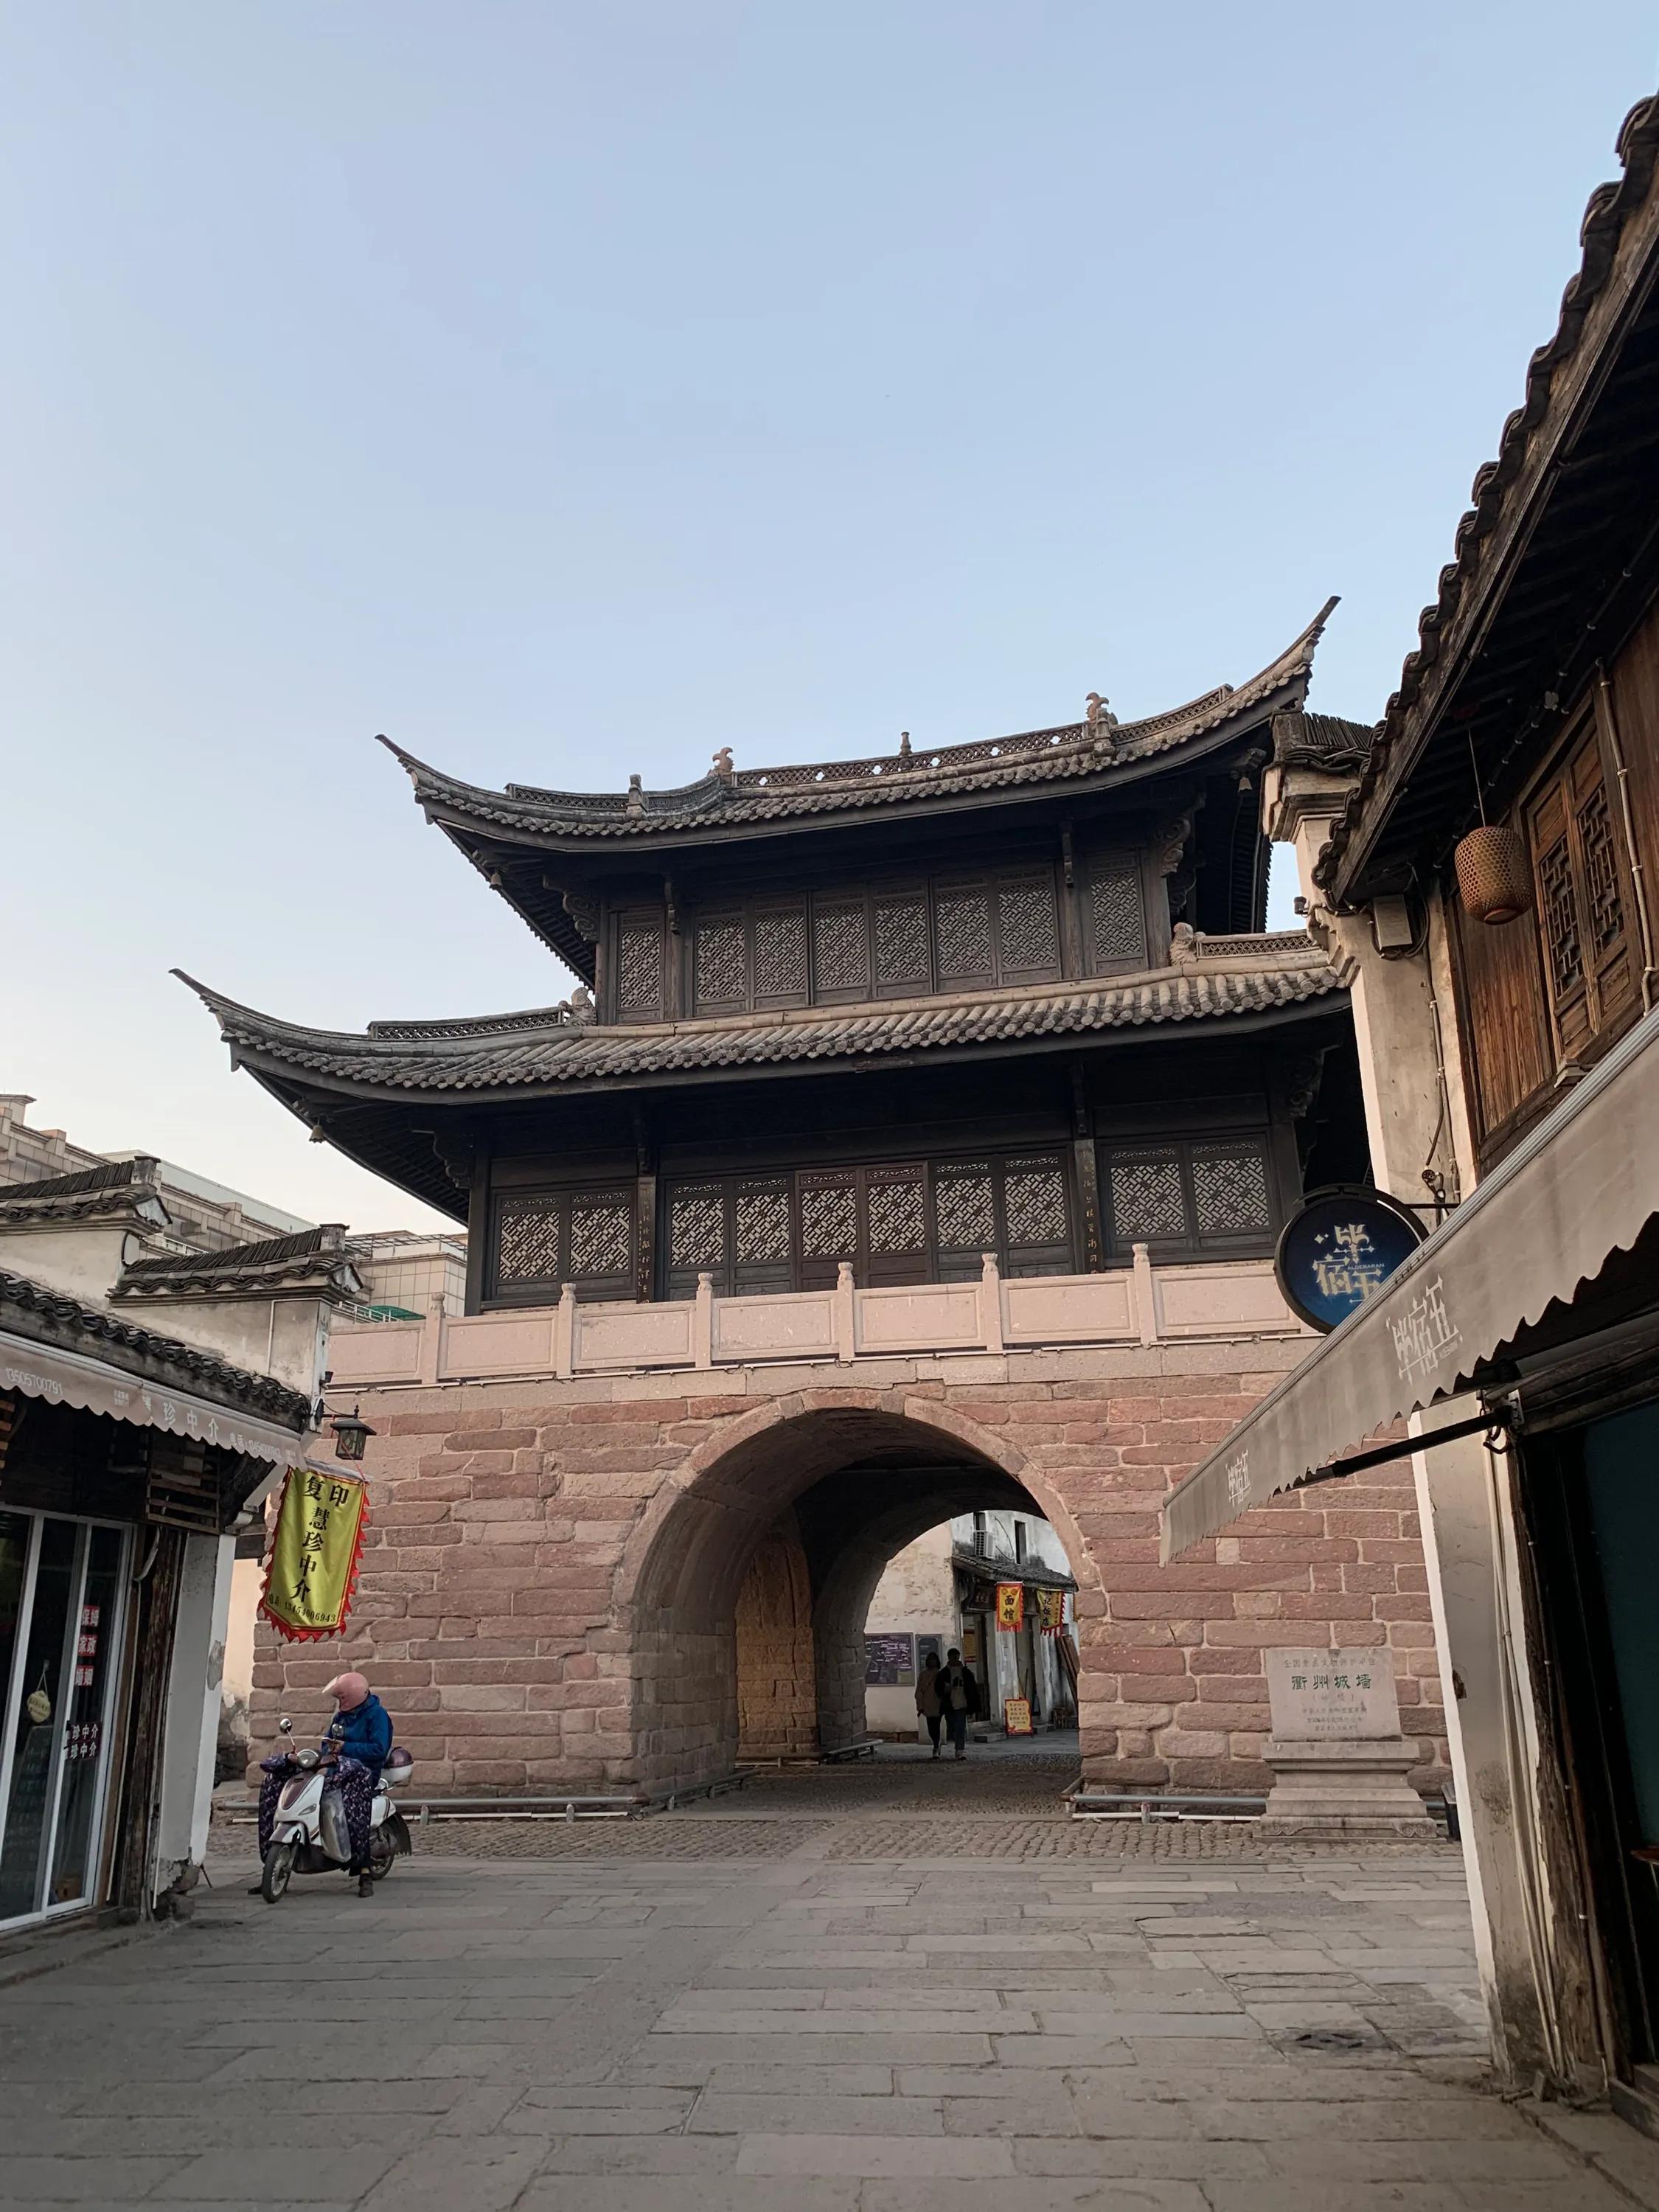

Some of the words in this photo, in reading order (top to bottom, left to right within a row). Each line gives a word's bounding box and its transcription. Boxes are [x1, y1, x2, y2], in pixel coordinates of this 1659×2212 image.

[303, 1475, 349, 1507] 复印
[290, 1506, 330, 1603] 慧珍中介
[1004, 1595, 1015, 1620] 面馆
[1291, 1674, 1371, 1691] 衢州城墙
